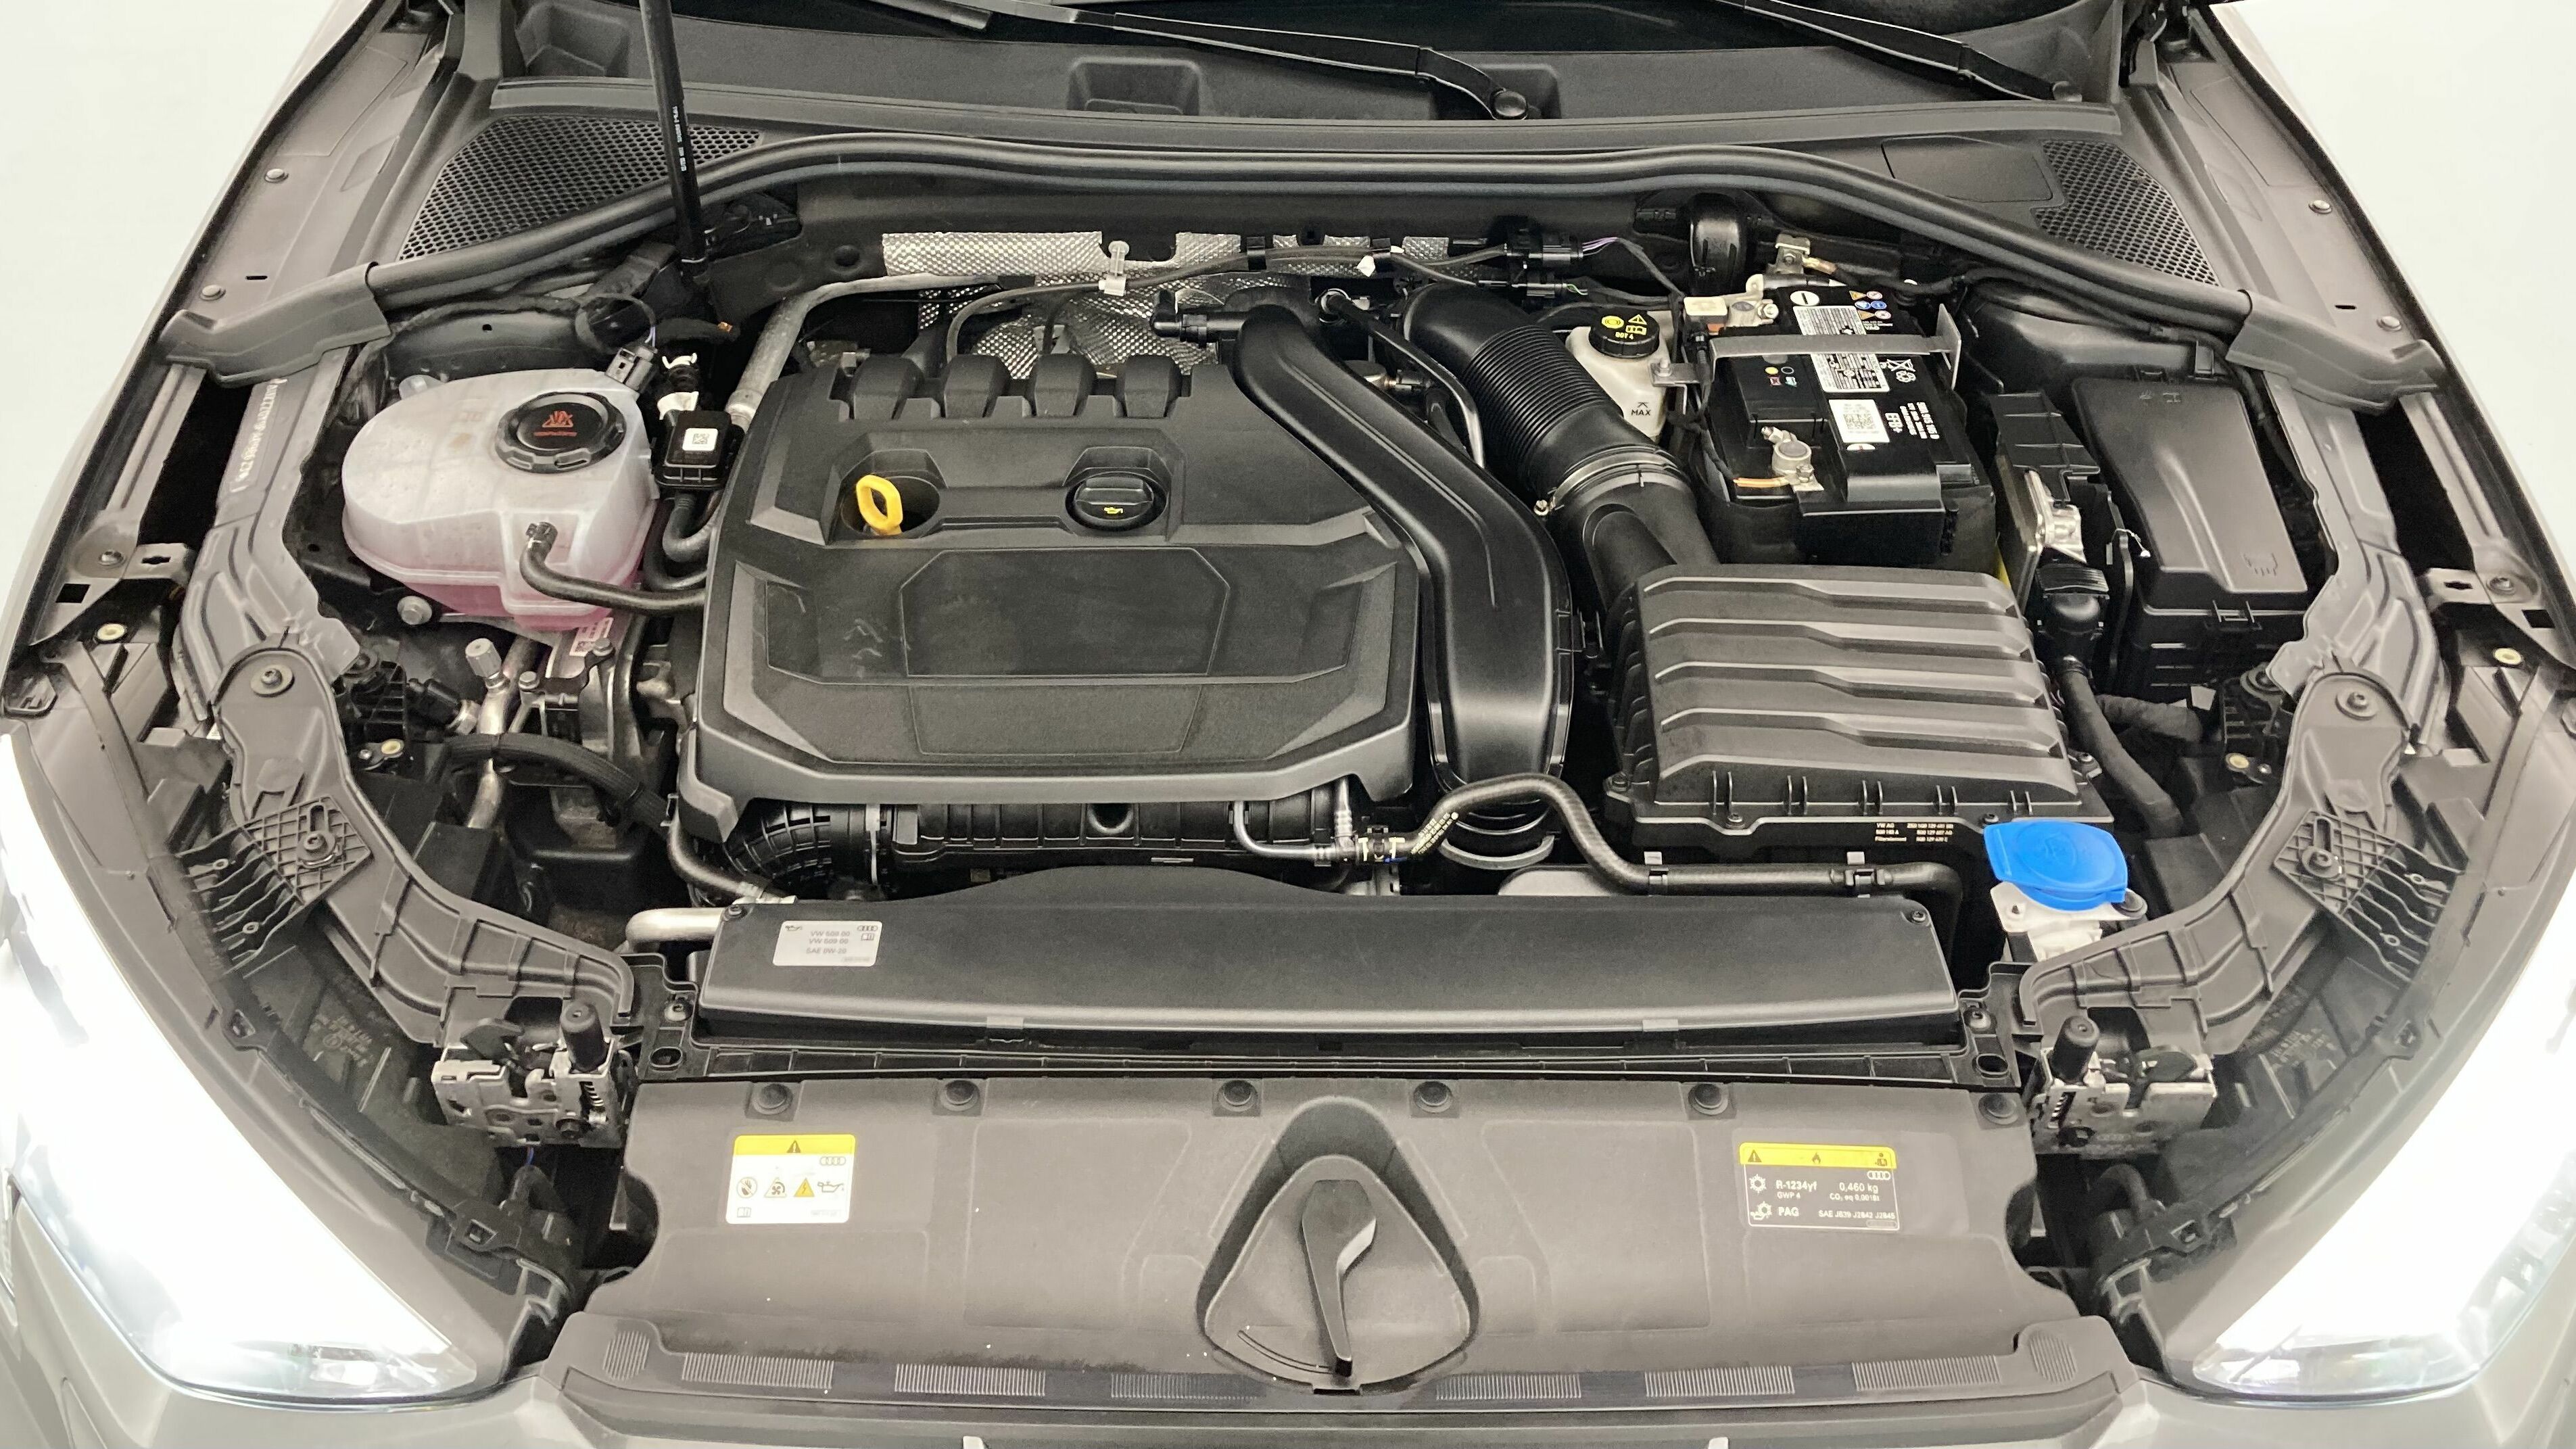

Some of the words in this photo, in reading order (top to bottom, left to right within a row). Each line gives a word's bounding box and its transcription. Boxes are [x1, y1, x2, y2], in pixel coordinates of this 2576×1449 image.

[1775, 1179, 1817, 1192] R-1234yf
[1839, 1182, 1865, 1192] 0,460
[1867, 1183, 1878, 1194] kg
[1778, 1207, 1799, 1217] PAG
[1818, 1210, 1833, 1218] SAE
